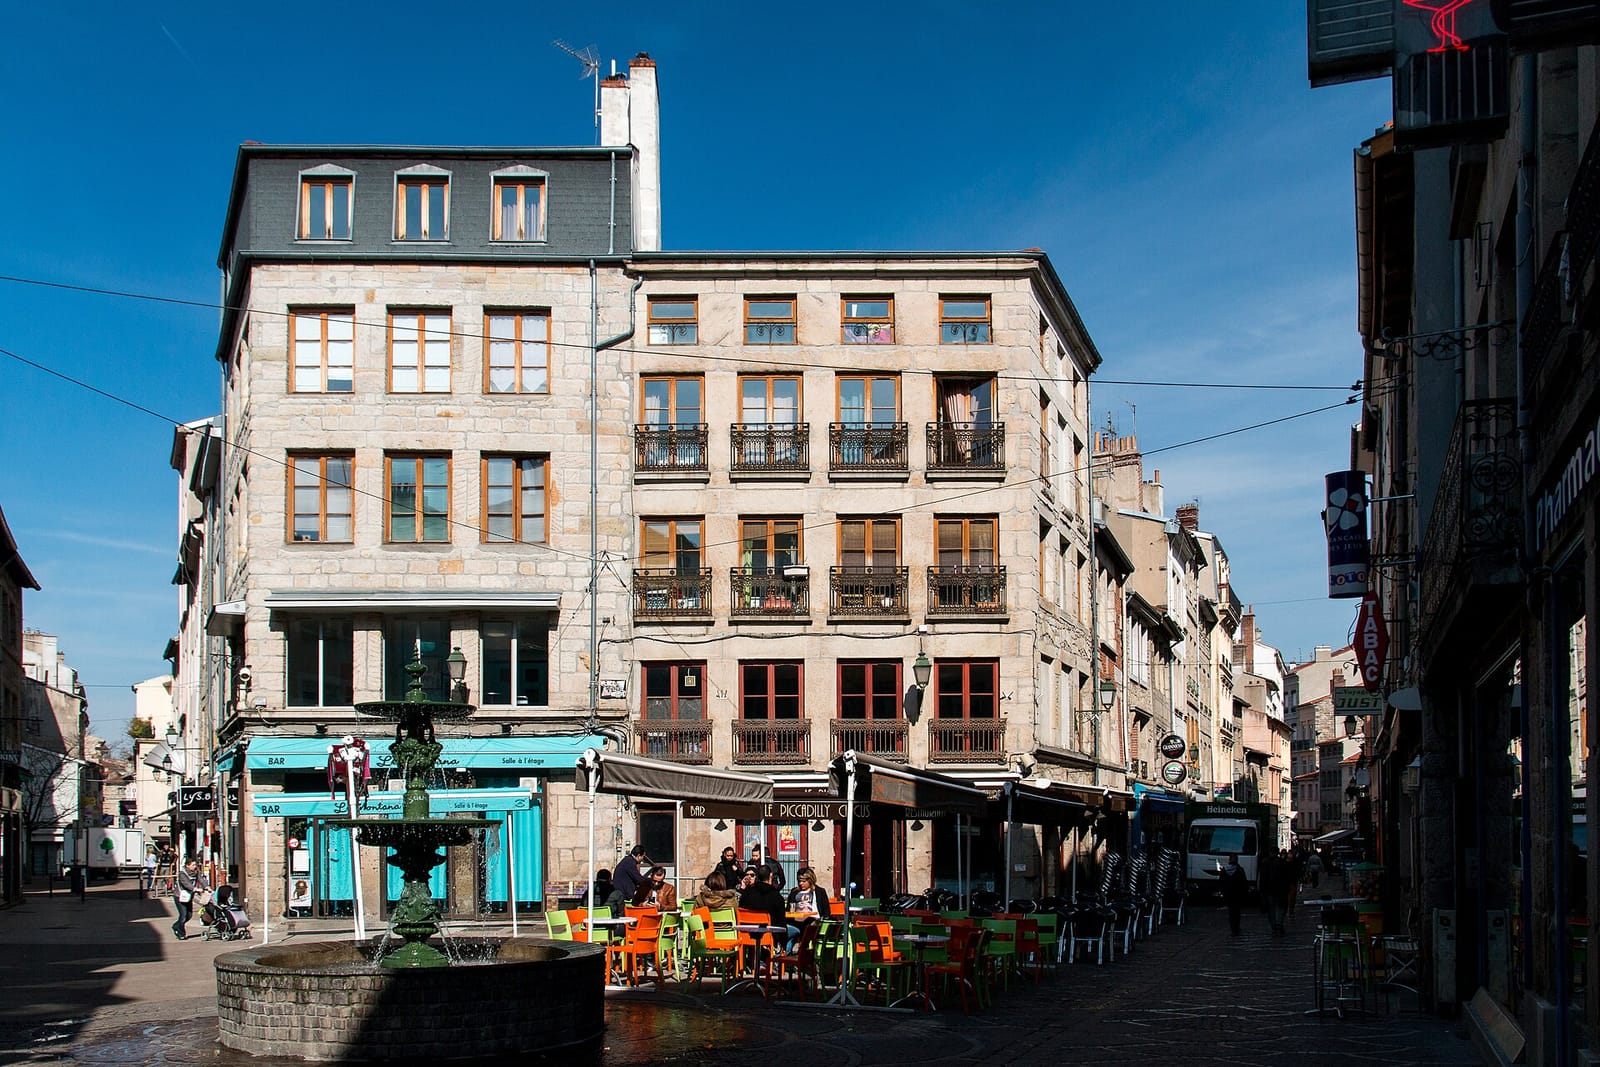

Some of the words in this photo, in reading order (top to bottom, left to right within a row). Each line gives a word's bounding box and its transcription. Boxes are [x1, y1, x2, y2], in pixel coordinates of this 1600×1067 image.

[1363, 600, 1379, 682] TABAC
[1336, 697, 1382, 708] JUST
[524, 757, 545, 766] l'étage
[262, 805, 281, 814] BAR
[472, 802, 488, 810] l'étage
[690, 805, 706, 817] BAR
[764, 804, 773, 817] LE
[780, 804, 831, 818] PICCADILLY
[838, 804, 871, 818] CICUS
[1206, 805, 1247, 814] Heineken
